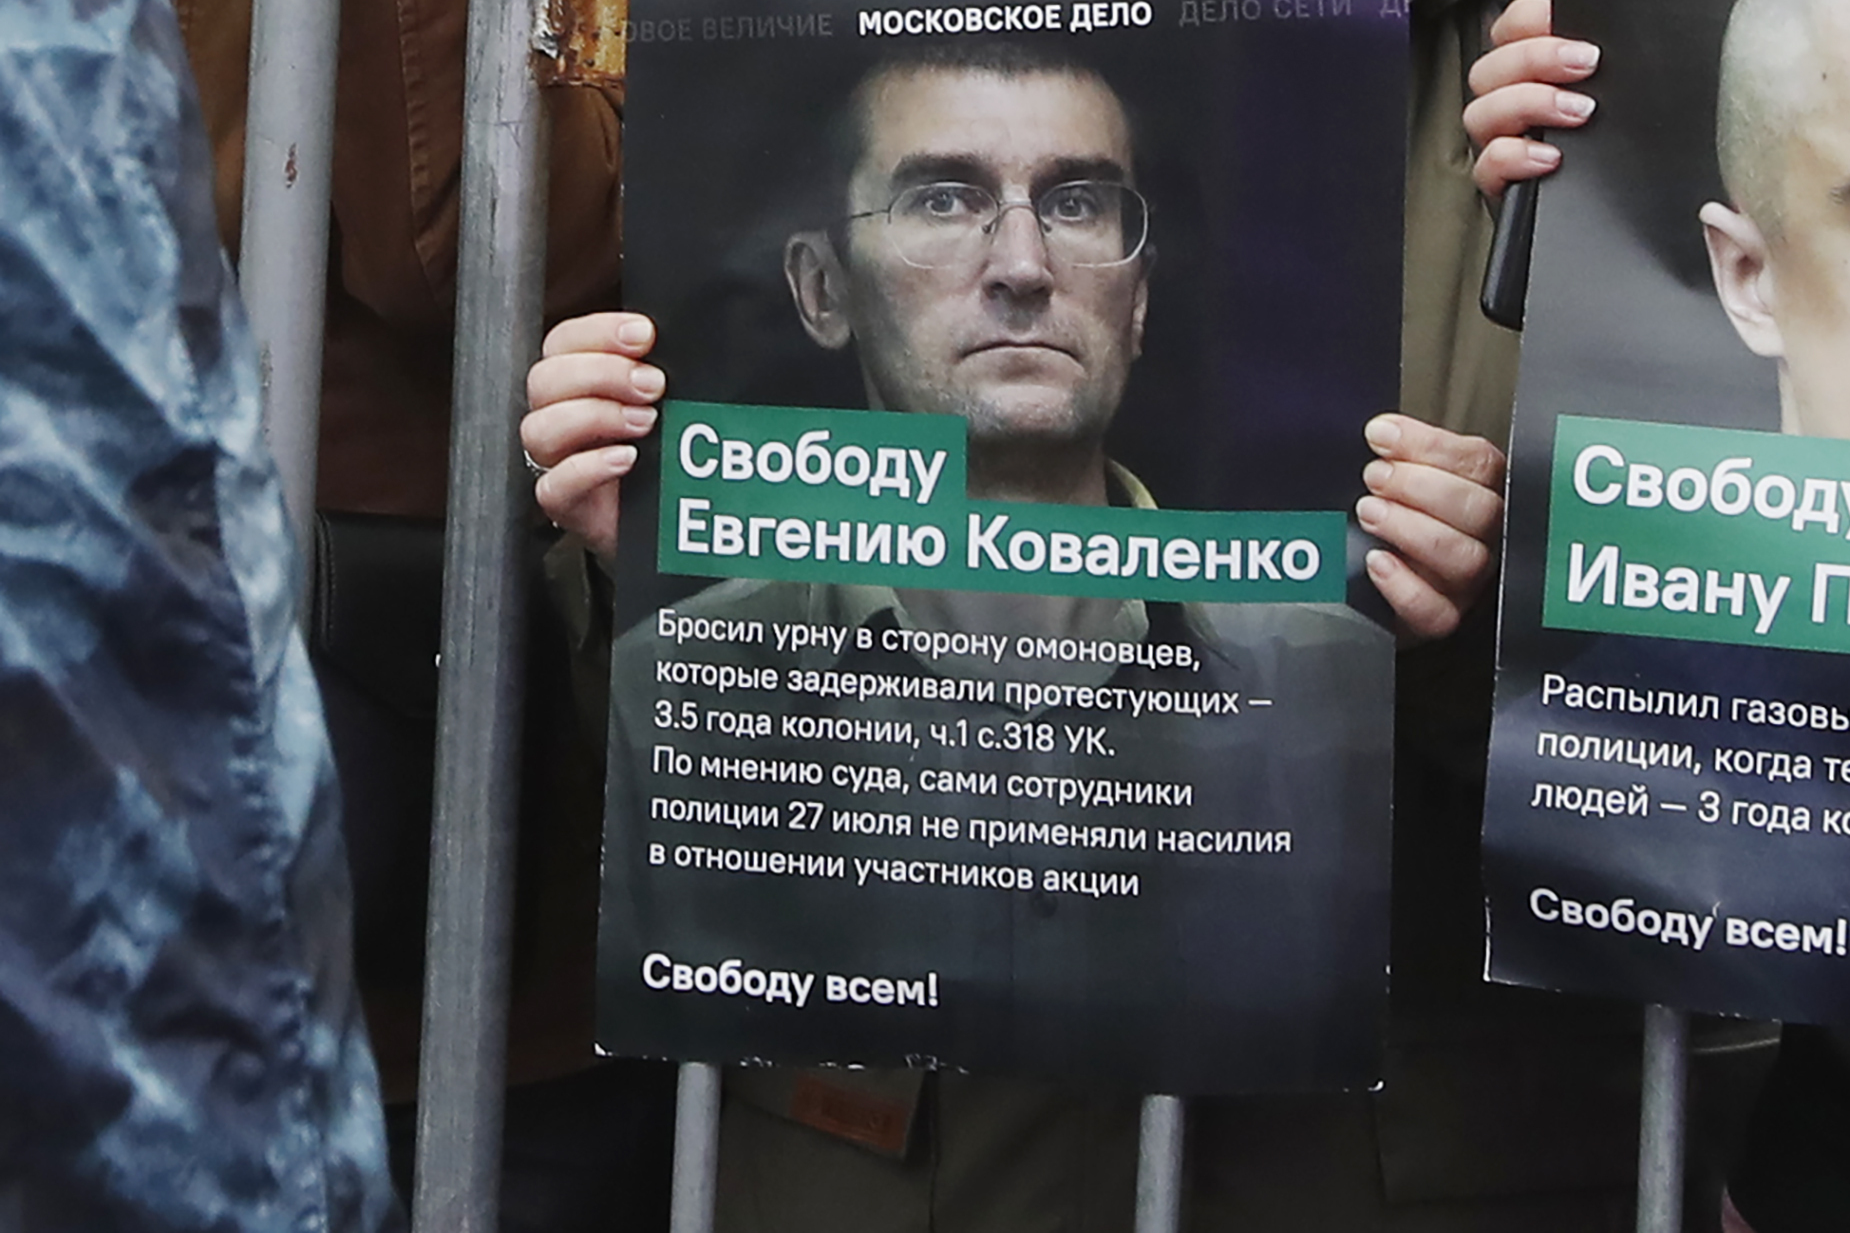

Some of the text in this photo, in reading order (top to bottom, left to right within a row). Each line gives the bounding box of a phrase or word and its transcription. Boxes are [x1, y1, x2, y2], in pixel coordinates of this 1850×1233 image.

[701, 13, 834, 40] ВЕЛИЧИЕ
[857, 4, 1063, 36] МОСКОВСКОЕ
[1068, 0, 1153, 33] ДЕЛО
[679, 422, 948, 505] Свободу
[677, 496, 1321, 581] Евгению Коваленко
[1566, 541, 1792, 636] Ивану
[657, 607, 1201, 673] Бросил урну в сторону омоновцев,
[655, 659, 780, 694] которые
[786, 669, 995, 703] задерживали
[1004, 681, 1240, 719] протестующих
[1541, 672, 1720, 721] Распылил
[653, 698, 1116, 757] 3.5 года колонии, ч.1 с.318 УК.
[652, 744, 1193, 809] По мнению суда, сами сотрудники
[1536, 731, 1702, 776] полиции,
[1713, 747, 1813, 784] когда
[650, 796, 1292, 854] полиции 27 июля не применяли насилия
[1530, 782, 1649, 819] людей
[1697, 789, 1721, 824] 3
[1731, 800, 1811, 836] года
[648, 842, 1140, 899] в отношении участников акции
[1529, 887, 1848, 957] Свободу всем!
[642, 952, 939, 1008] Свободу всем!
